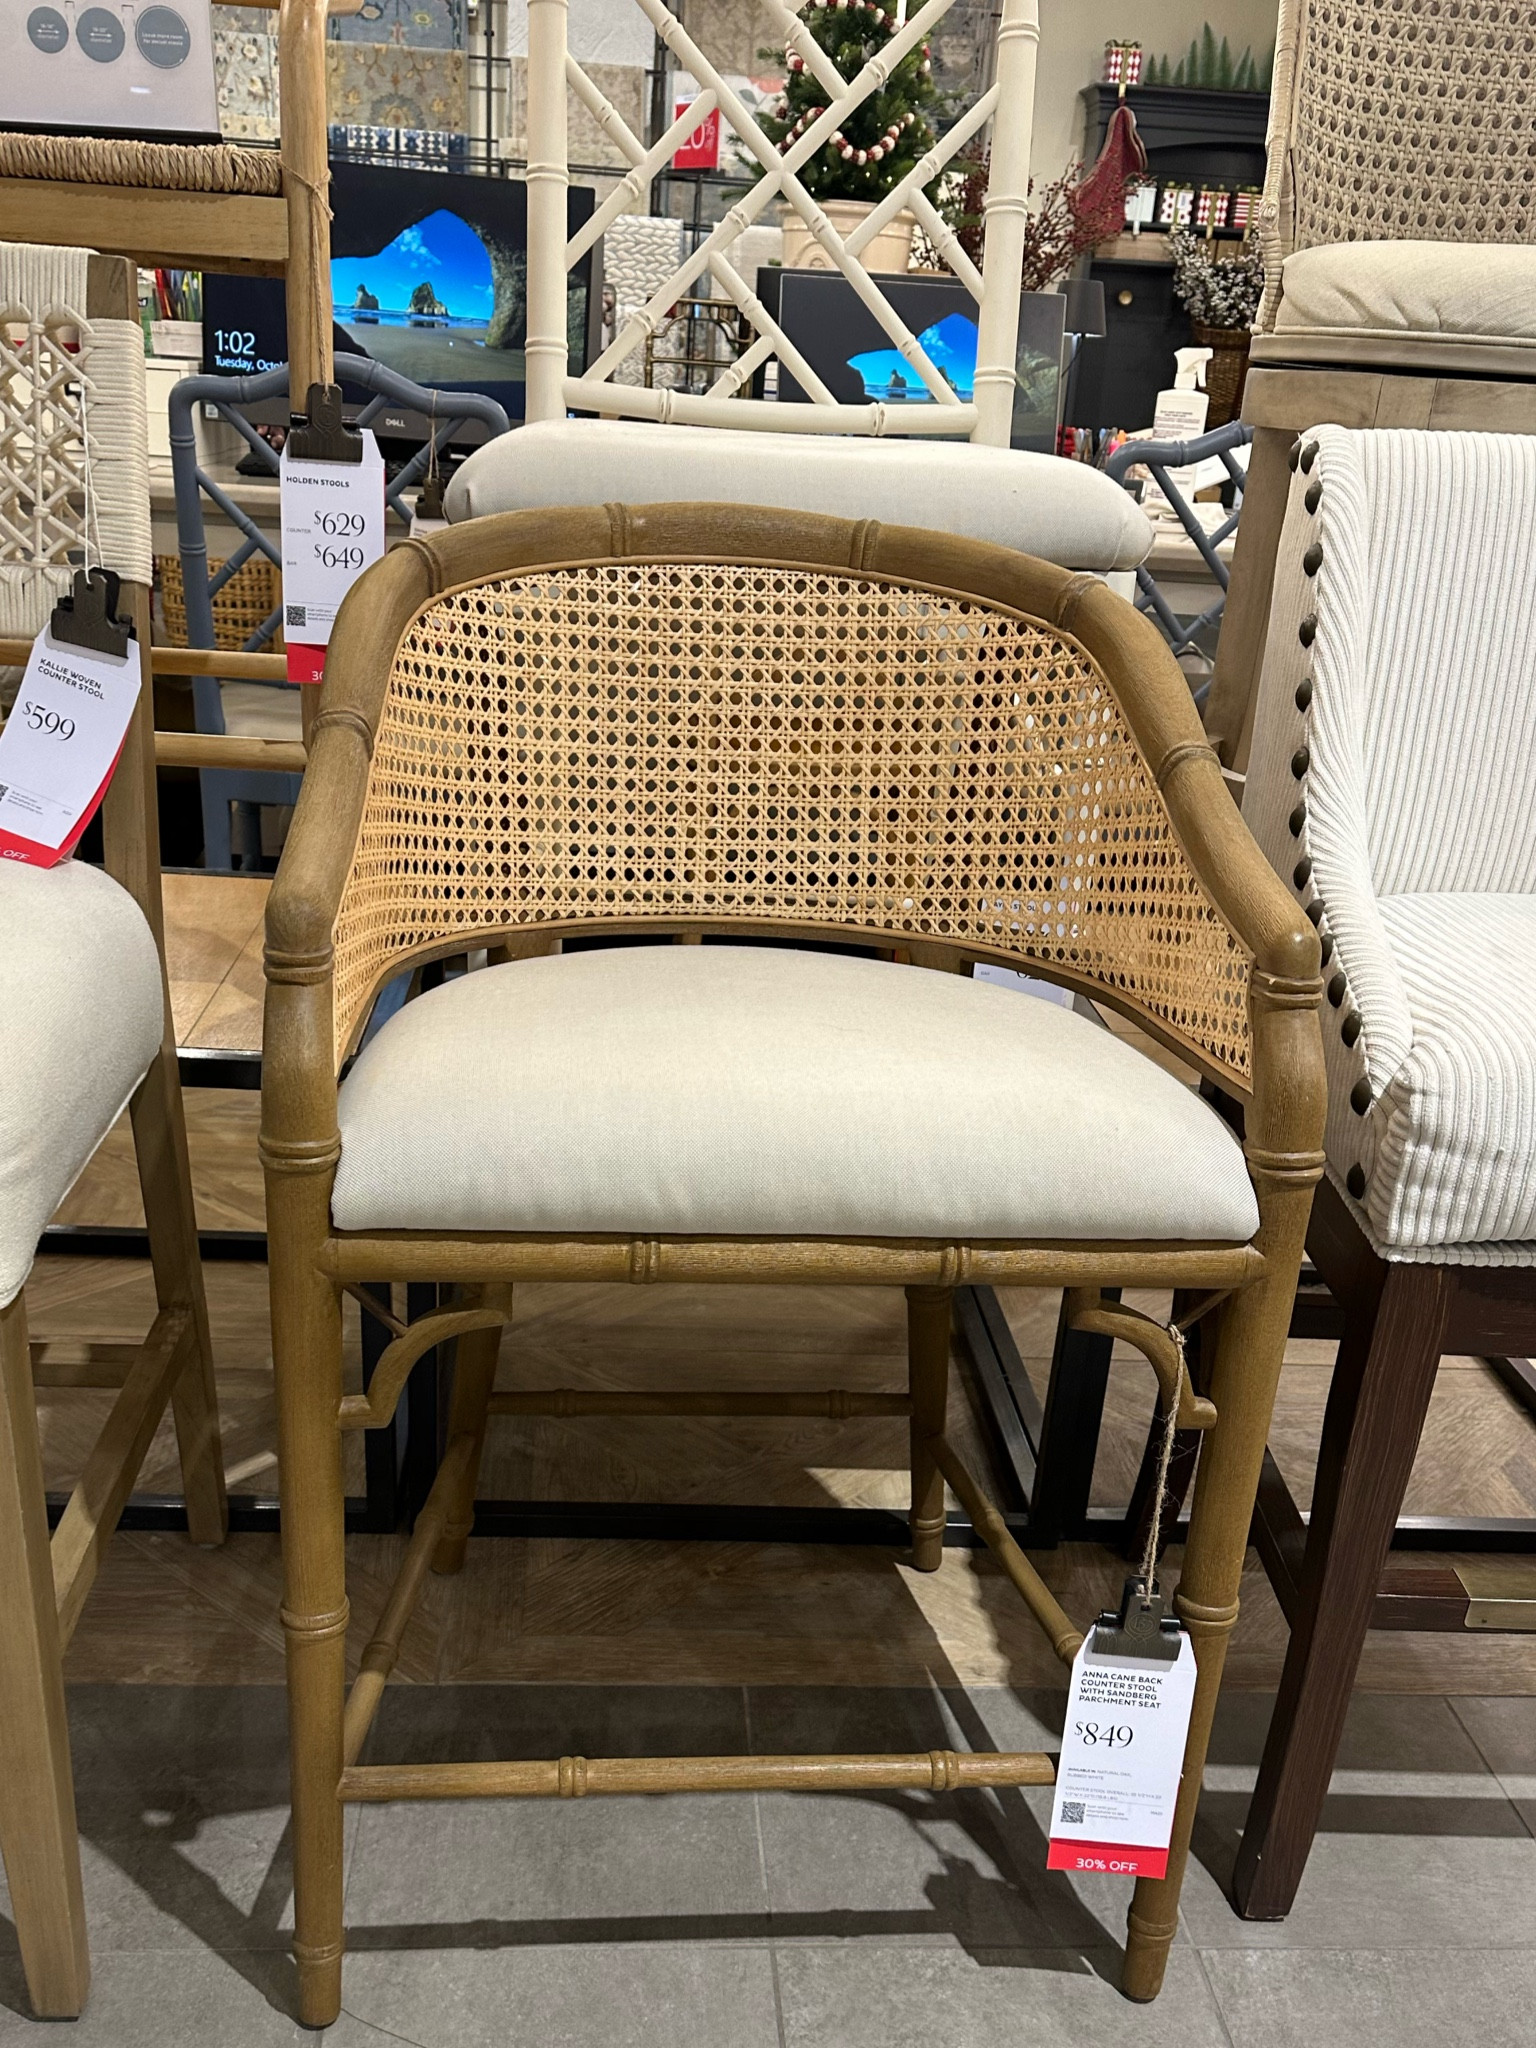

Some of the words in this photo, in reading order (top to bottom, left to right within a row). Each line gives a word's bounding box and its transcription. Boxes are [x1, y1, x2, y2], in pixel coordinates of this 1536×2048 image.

[215, 330, 256, 355] 1:02
[215, 355, 255, 372] Tuesday,
[386, 418, 406, 428] DELL
[287, 476, 319, 485] HOLDEN
[320, 479, 350, 488] STOOLS
[314, 510, 365, 537] $629
[314, 544, 364, 570] $649
[40, 658, 69, 675] KALLIE
[71, 670, 102, 689] WOVEN
[38, 666, 77, 688] COUNTER
[79, 683, 105, 700] STOOL
[22, 701, 76, 741] $599
[4, 850, 31, 860] OFF
[1081, 1679, 1126, 1689] COUNTER
[1128, 1683, 1157, 1692] STOOL
[1082, 1671, 1109, 1679] ANNA
[1111, 1674, 1136, 1682] CANE
[1139, 1676, 1163, 1685] BACK
[1080, 1687, 1105, 1696] WITH
[1107, 1690, 1157, 1701] SANDBERG
[1079, 1695, 1136, 1707] PARCHMENT
[1139, 1701, 1161, 1709] SEAT
[1075, 1721, 1133, 1749] $849
[1076, 1858, 1106, 1870] 30%
[1110, 1861, 1138, 1872] OFF
